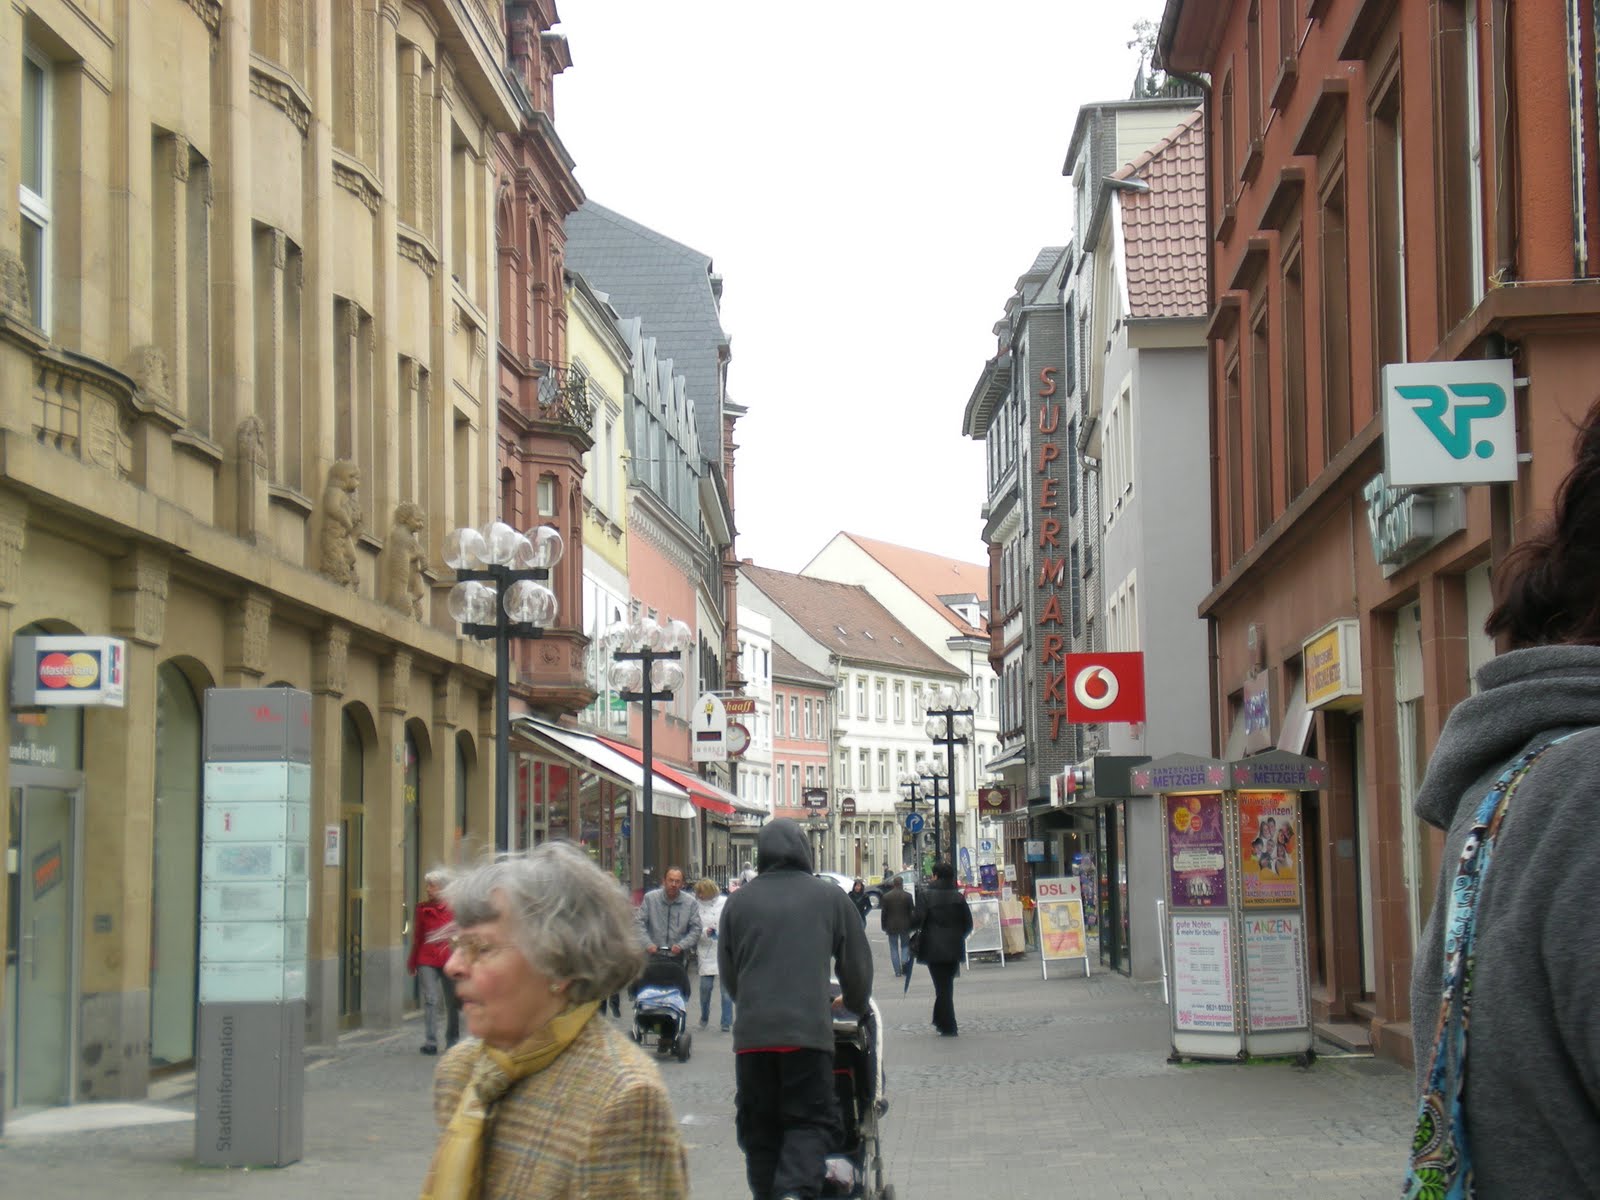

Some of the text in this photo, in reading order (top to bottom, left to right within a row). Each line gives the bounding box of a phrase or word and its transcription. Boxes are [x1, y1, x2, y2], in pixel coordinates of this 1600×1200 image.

[1038, 366, 1066, 741] SUPERMARKT
[40, 665, 95, 676] MasterCard
[1153, 765, 1205, 775] TANZSCHULE
[1254, 763, 1305, 772] TANZSCHULE
[1153, 773, 1205, 788] METZGER
[1254, 771, 1306, 785] METZGER
[1039, 884, 1067, 896] DSL
[1246, 919, 1292, 934] TANZEN
[216, 1015, 233, 1152] Stadtinformation
